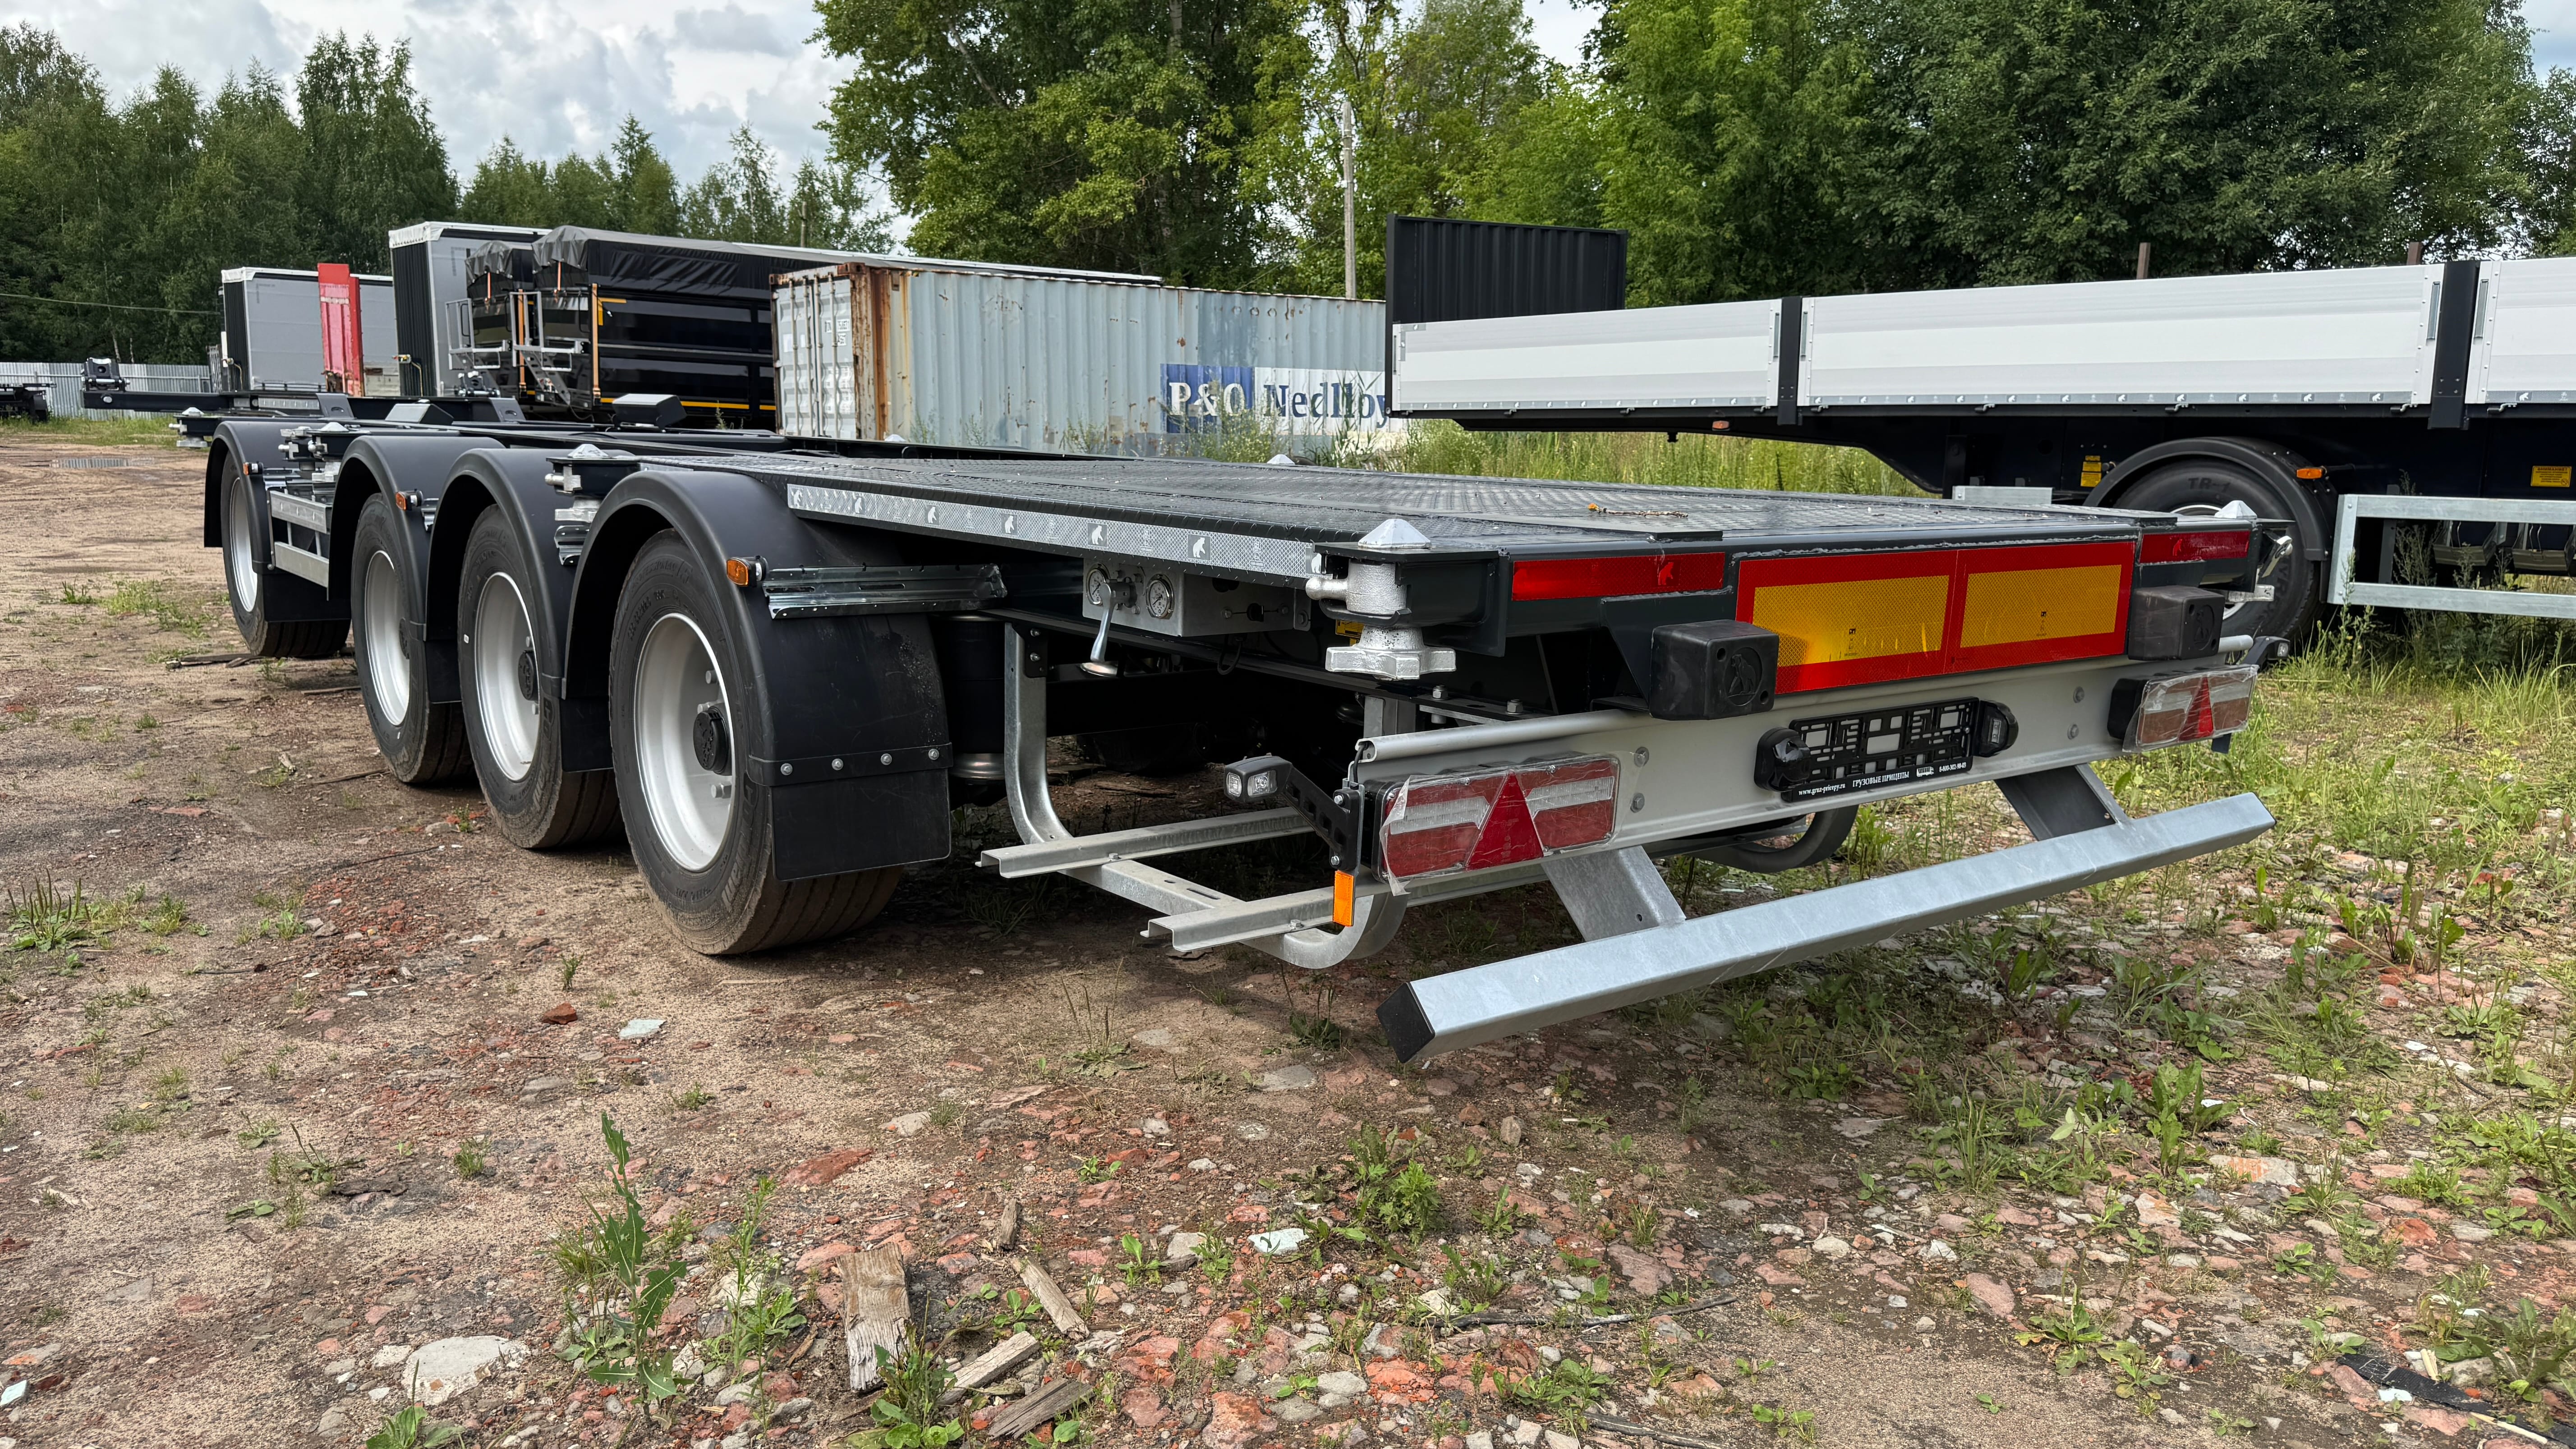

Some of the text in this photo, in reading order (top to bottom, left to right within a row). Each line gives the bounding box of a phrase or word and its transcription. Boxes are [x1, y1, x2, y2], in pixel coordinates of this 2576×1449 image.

[1169, 382, 1245, 417] P&O
[1852, 771, 1909, 788] ГРУЗОВЫЕ ПРИЦЕПЫ
